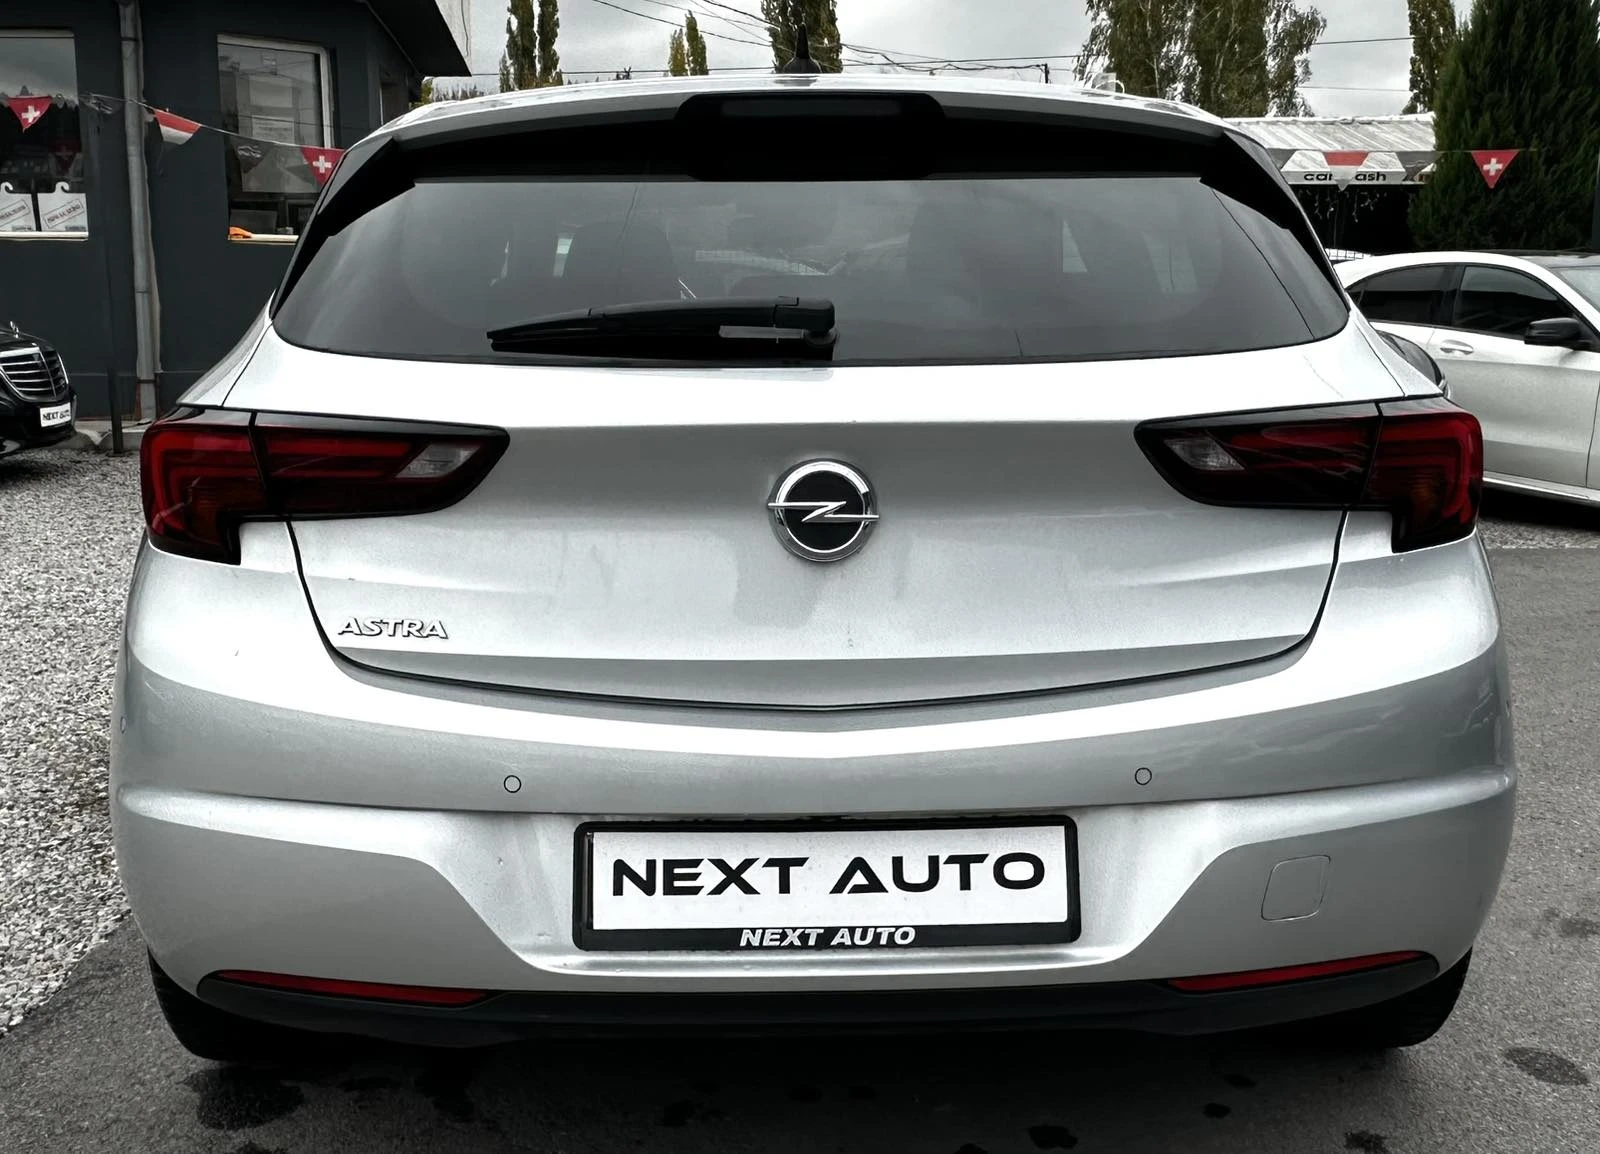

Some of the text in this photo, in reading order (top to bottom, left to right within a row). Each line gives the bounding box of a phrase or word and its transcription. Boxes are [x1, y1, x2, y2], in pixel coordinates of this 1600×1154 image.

[1354, 171, 1387, 182] ash
[337, 617, 449, 640] ASTRA
[612, 852, 1046, 897] NEXT AUTO
[739, 926, 916, 947] NEXT AUTO
